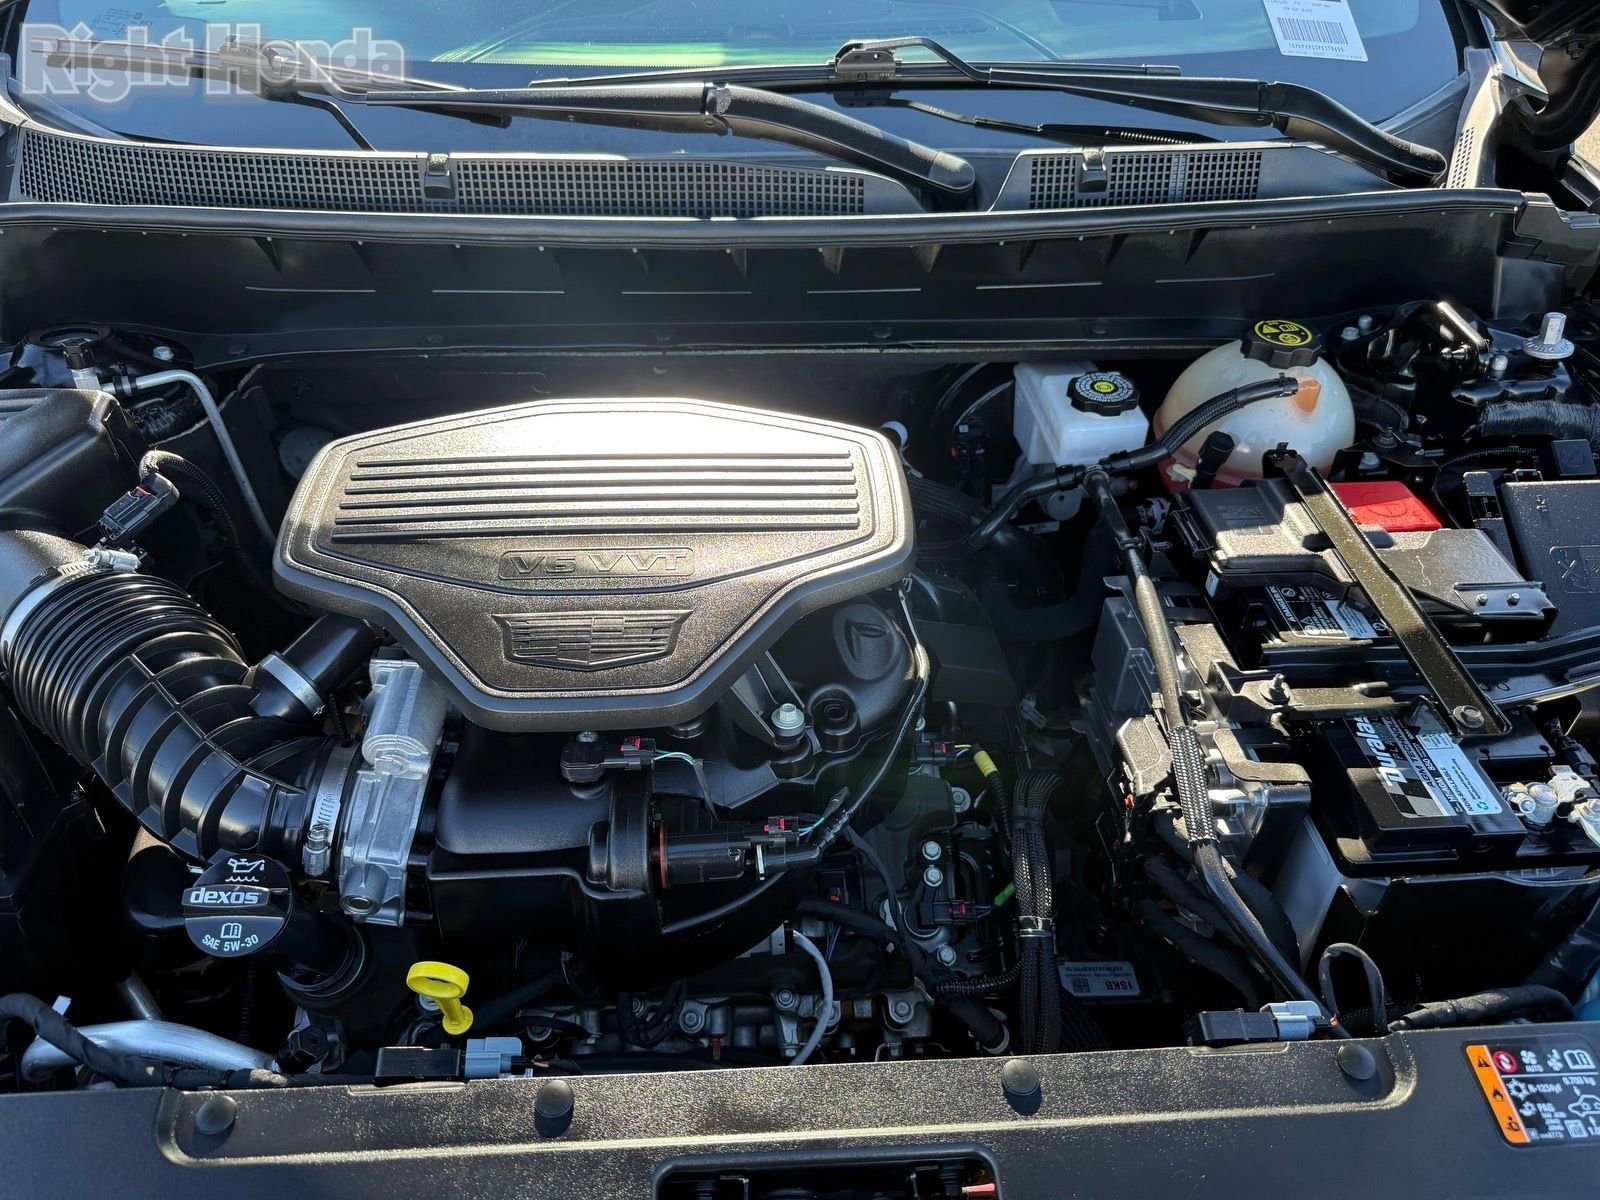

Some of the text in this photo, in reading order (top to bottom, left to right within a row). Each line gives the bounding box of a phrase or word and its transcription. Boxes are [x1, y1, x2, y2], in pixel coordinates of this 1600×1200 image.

[510, 554, 687, 574] V6 VVT
[1422, 758, 1437, 772] 850
[1415, 764, 1436, 789] AGM
[189, 887, 260, 905] dexos
[202, 934, 259, 952] SAE 5W-30
[1525, 1064, 1544, 1072] AUTO
